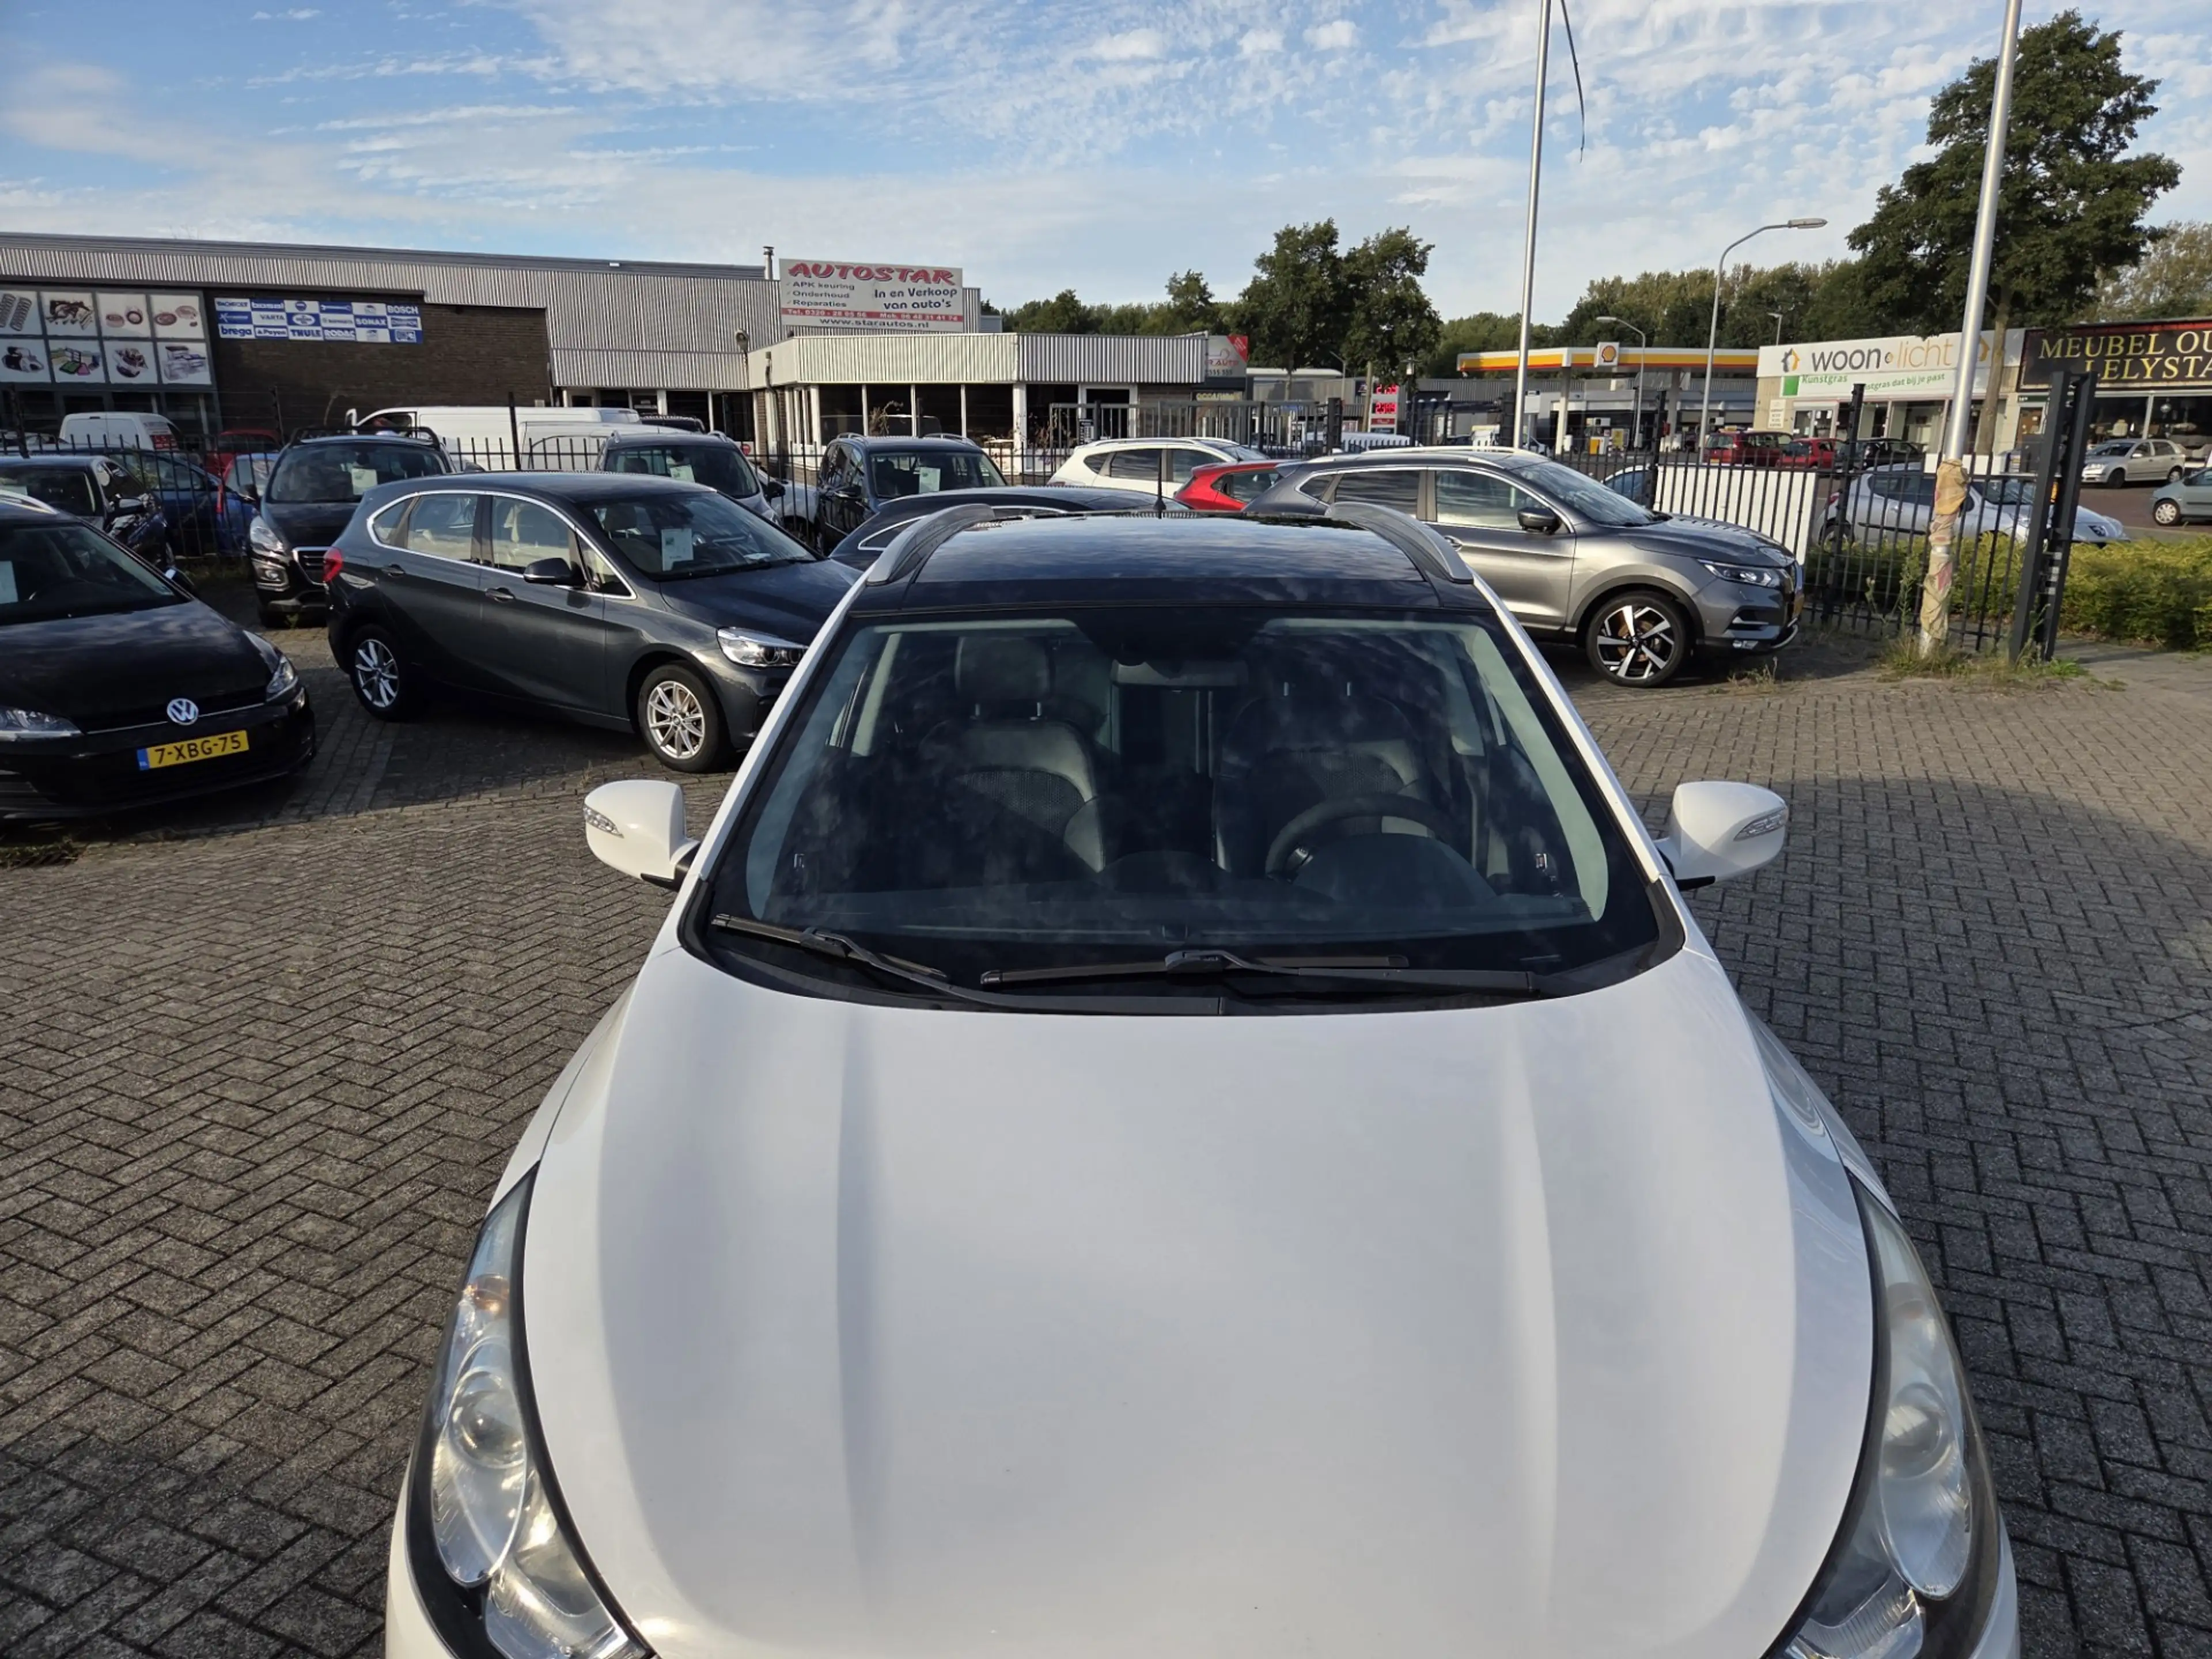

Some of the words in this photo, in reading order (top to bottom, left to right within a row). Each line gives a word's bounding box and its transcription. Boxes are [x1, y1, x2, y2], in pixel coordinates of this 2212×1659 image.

[788, 263, 956, 286] AUTOSTAR
[818, 282, 855, 290] keuring
[792, 290, 850, 298] Onderhoud
[874, 289, 886, 298] In
[890, 290, 904, 298] en
[908, 287, 957, 298] Verkoop
[387, 305, 419, 314] BOSCH
[793, 300, 847, 308] Reparaties
[884, 302, 907, 310] van
[911, 298, 952, 309] auto's
[355, 317, 386, 325] SONAX
[820, 318, 929, 328] www.starautos.nl
[290, 329, 321, 337] THULE
[2038, 334, 2166, 359] MEUBEL
[1812, 348, 1881, 372] woon
[1896, 339, 1953, 368] licht
[1801, 374, 1848, 385] Kunstgras
[1892, 378, 1905, 387] dat
[1926, 373, 1945, 384] past
[154, 733, 241, 764] 7-XBG-75
